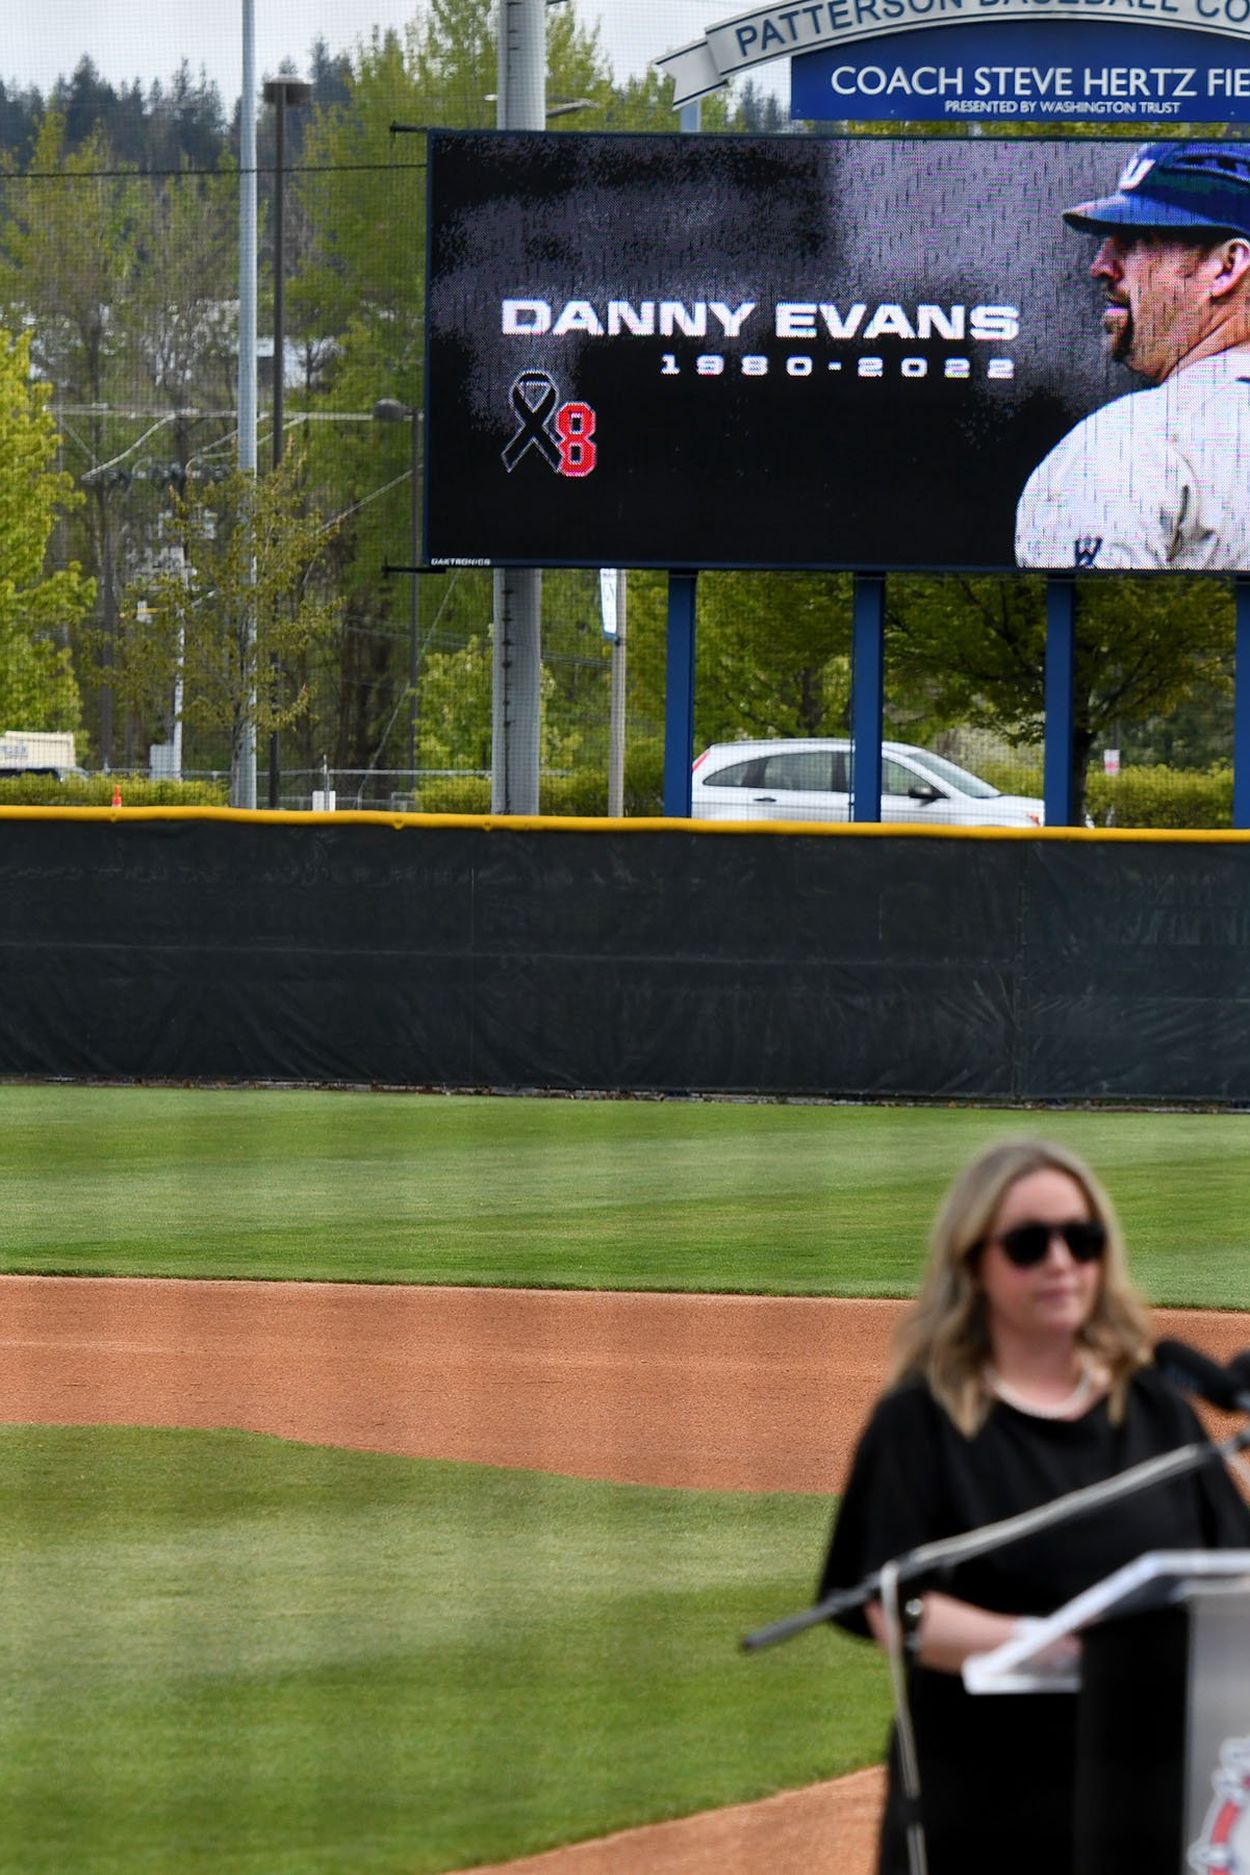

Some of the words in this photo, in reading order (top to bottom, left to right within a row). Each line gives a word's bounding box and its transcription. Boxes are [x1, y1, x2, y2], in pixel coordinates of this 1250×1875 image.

[831, 66, 964, 95] COACH
[974, 66, 1073, 96] STEVE
[1084, 67, 1198, 97] HERTZ
[944, 100, 1018, 113] PRESENTED
[1020, 101, 1036, 113] BY
[1040, 101, 1136, 113] WASHINGTON
[1139, 101, 1181, 114] TRUST
[501, 299, 756, 337] DANNY
[775, 302, 1020, 341] EVANS
[660, 353, 1015, 379] 1980-2022
[556, 402, 597, 478] 8
